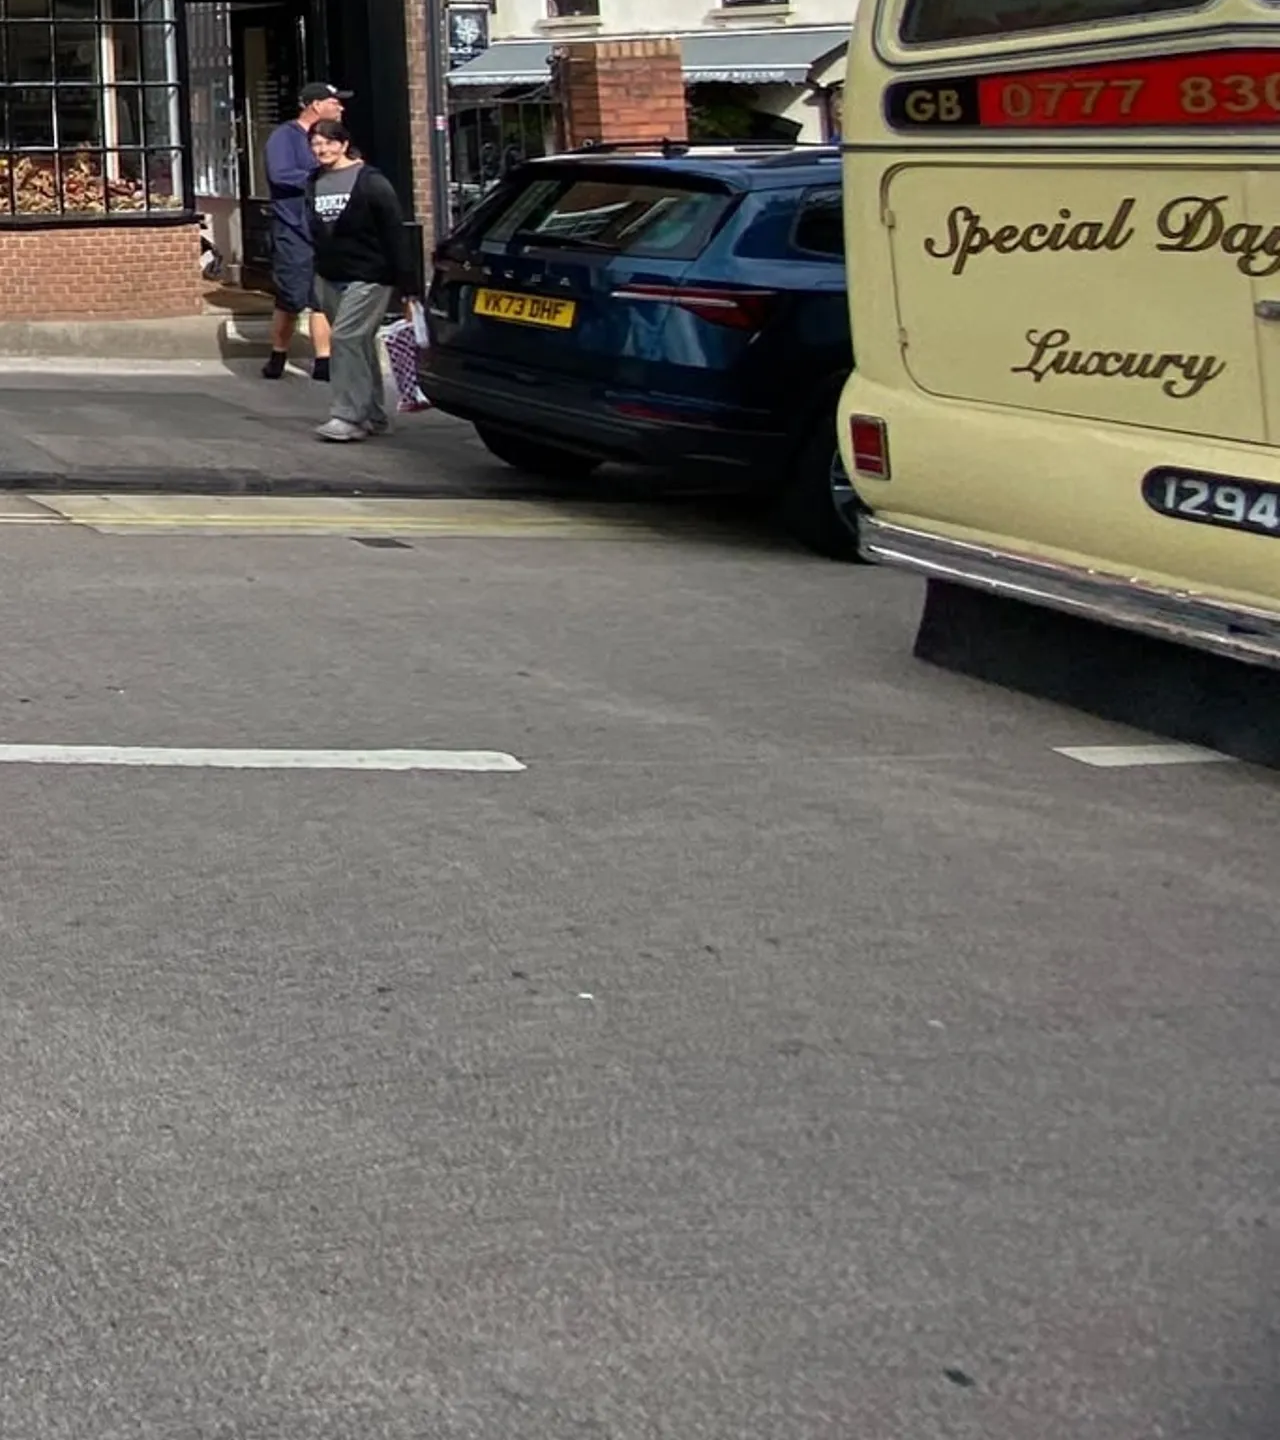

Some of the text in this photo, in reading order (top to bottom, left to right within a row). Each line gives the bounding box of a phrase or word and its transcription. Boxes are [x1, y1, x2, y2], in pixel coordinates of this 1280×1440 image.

[905, 90, 962, 121] GB
[1001, 79, 1144, 118] 0777
[924, 198, 1136, 276] Special
[1011, 329, 1226, 398] Luxury
[1164, 476, 1280, 528] 1294
